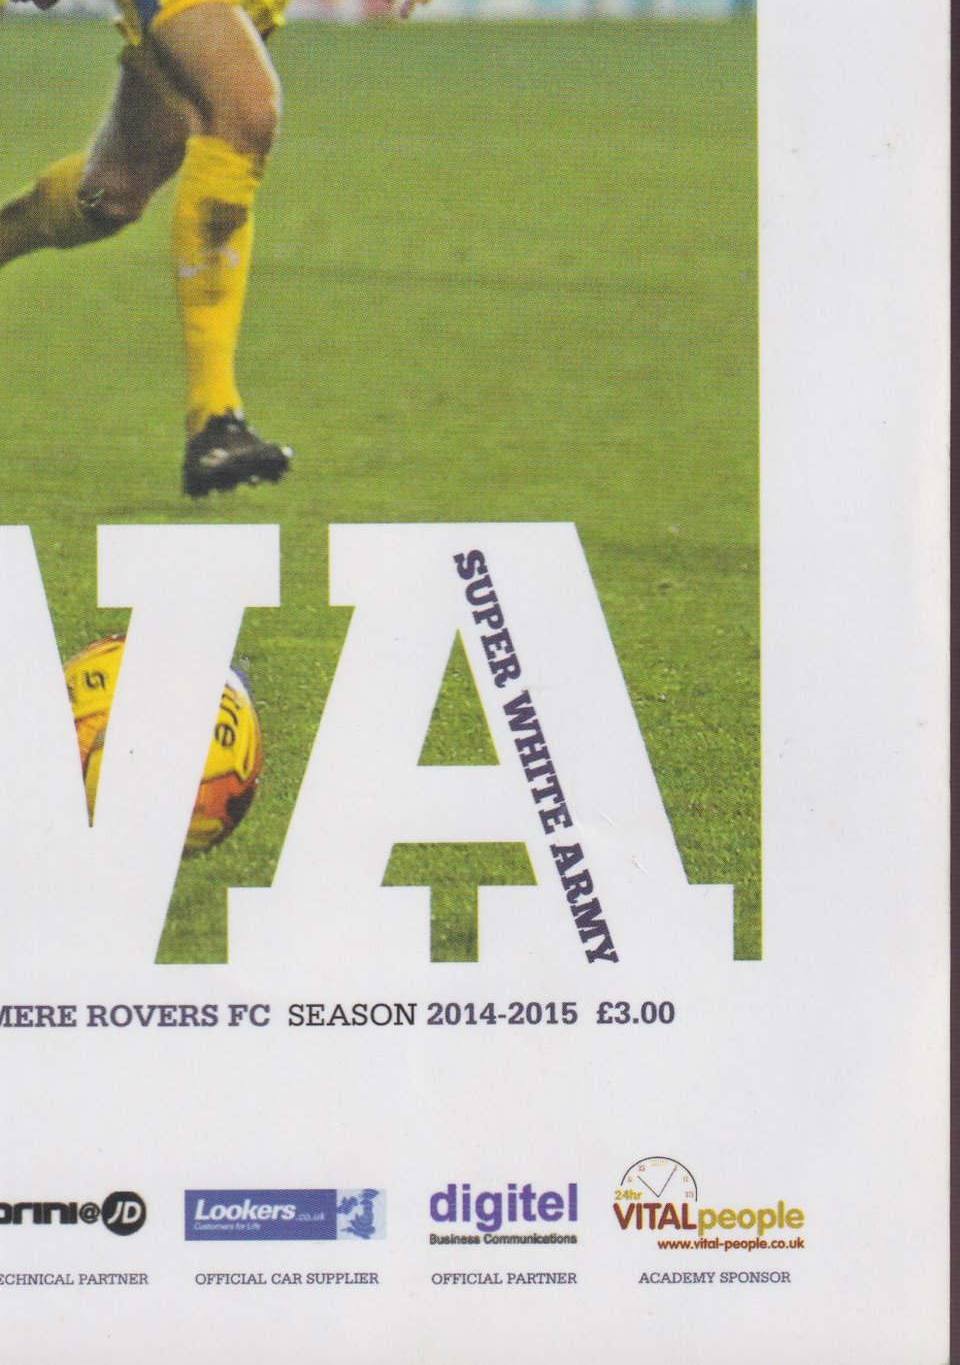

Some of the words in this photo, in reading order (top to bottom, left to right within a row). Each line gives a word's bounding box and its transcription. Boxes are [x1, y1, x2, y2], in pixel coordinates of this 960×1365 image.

[453, 549, 522, 689] SUPER
[502, 690, 574, 835] WHITE
[549, 843, 620, 964] ARMY
[87, 1004, 219, 1029] ROVERS
[228, 1004, 271, 1028] FC
[288, 1003, 418, 1028] SEASON
[427, 1002, 579, 1027] 2014-2015
[597, 1001, 677, 1026] £3.00
[615, 1190, 643, 1201] 24hr
[430, 1183, 578, 1232] digitel
[429, 1234, 481, 1245] Business
[484, 1233, 578, 1245] Communications
[658, 1237, 806, 1252] www.vital-people.co.uk
[79, 1273, 150, 1286] PARTNER
[195, 1273, 267, 1286] OFFICIAL
[271, 1273, 304, 1286] CAR
[307, 1273, 380, 1286] SUPPLIER
[432, 1273, 504, 1286] OFFICIAL
[507, 1273, 578, 1286] PARTNER
[639, 1272, 716, 1285] ACADEMY
[720, 1272, 792, 1285] SPONSOR
